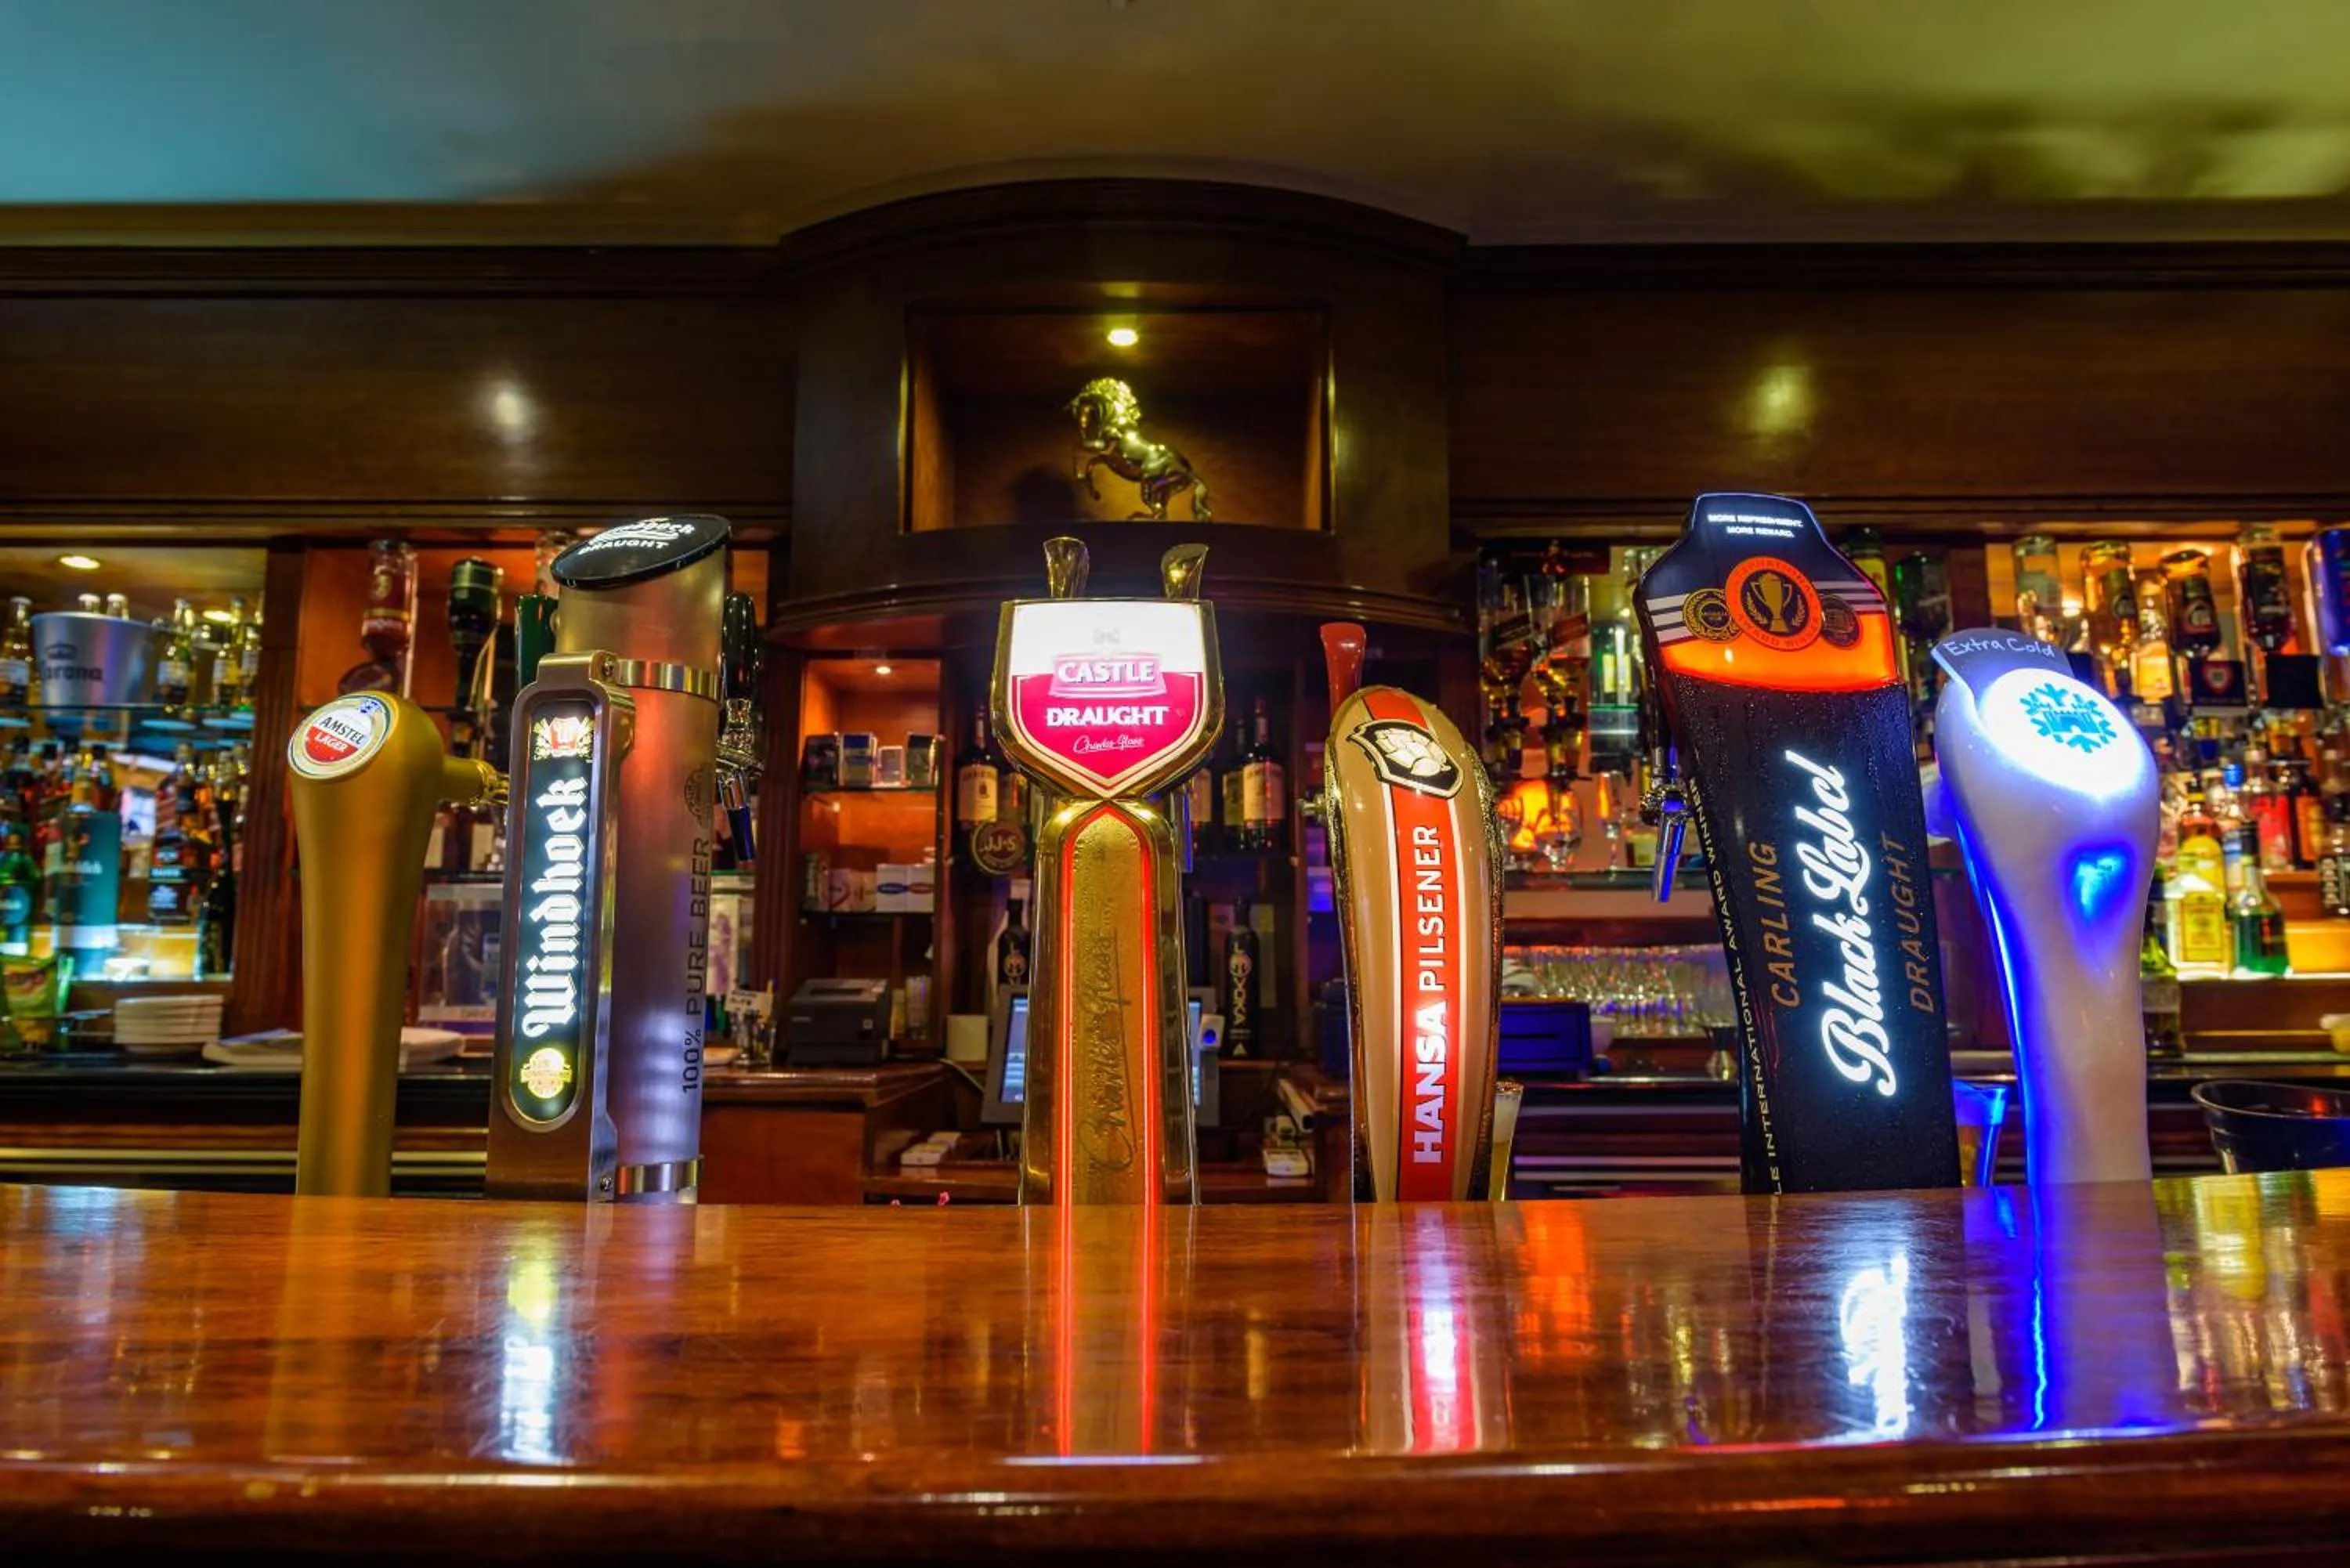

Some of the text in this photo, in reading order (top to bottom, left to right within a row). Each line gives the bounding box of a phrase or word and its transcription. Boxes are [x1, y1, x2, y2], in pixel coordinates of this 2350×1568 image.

[1058, 661, 1155, 683] CASTLE
[1943, 636, 2055, 658] Extra Cold
[313, 731, 351, 752] LAGER
[319, 716, 365, 745] AMSTEL
[1046, 706, 1170, 727] DRAUGHT
[1784, 750, 1871, 916] Label
[520, 776, 588, 1038] Windhoek
[689, 836, 710, 918] BEER
[1712, 869, 1738, 950] AWARD
[1748, 840, 1802, 1009] CARLING
[1880, 831, 1935, 1014] DRAUGHT
[685, 930, 705, 1017] PURE
[1412, 826, 1449, 1165] HANSA PILSENER
[1811, 911, 1897, 1097] Black
[682, 1029, 702, 1094] 100%
[1734, 958, 1777, 1158] INTERNATIONAL
